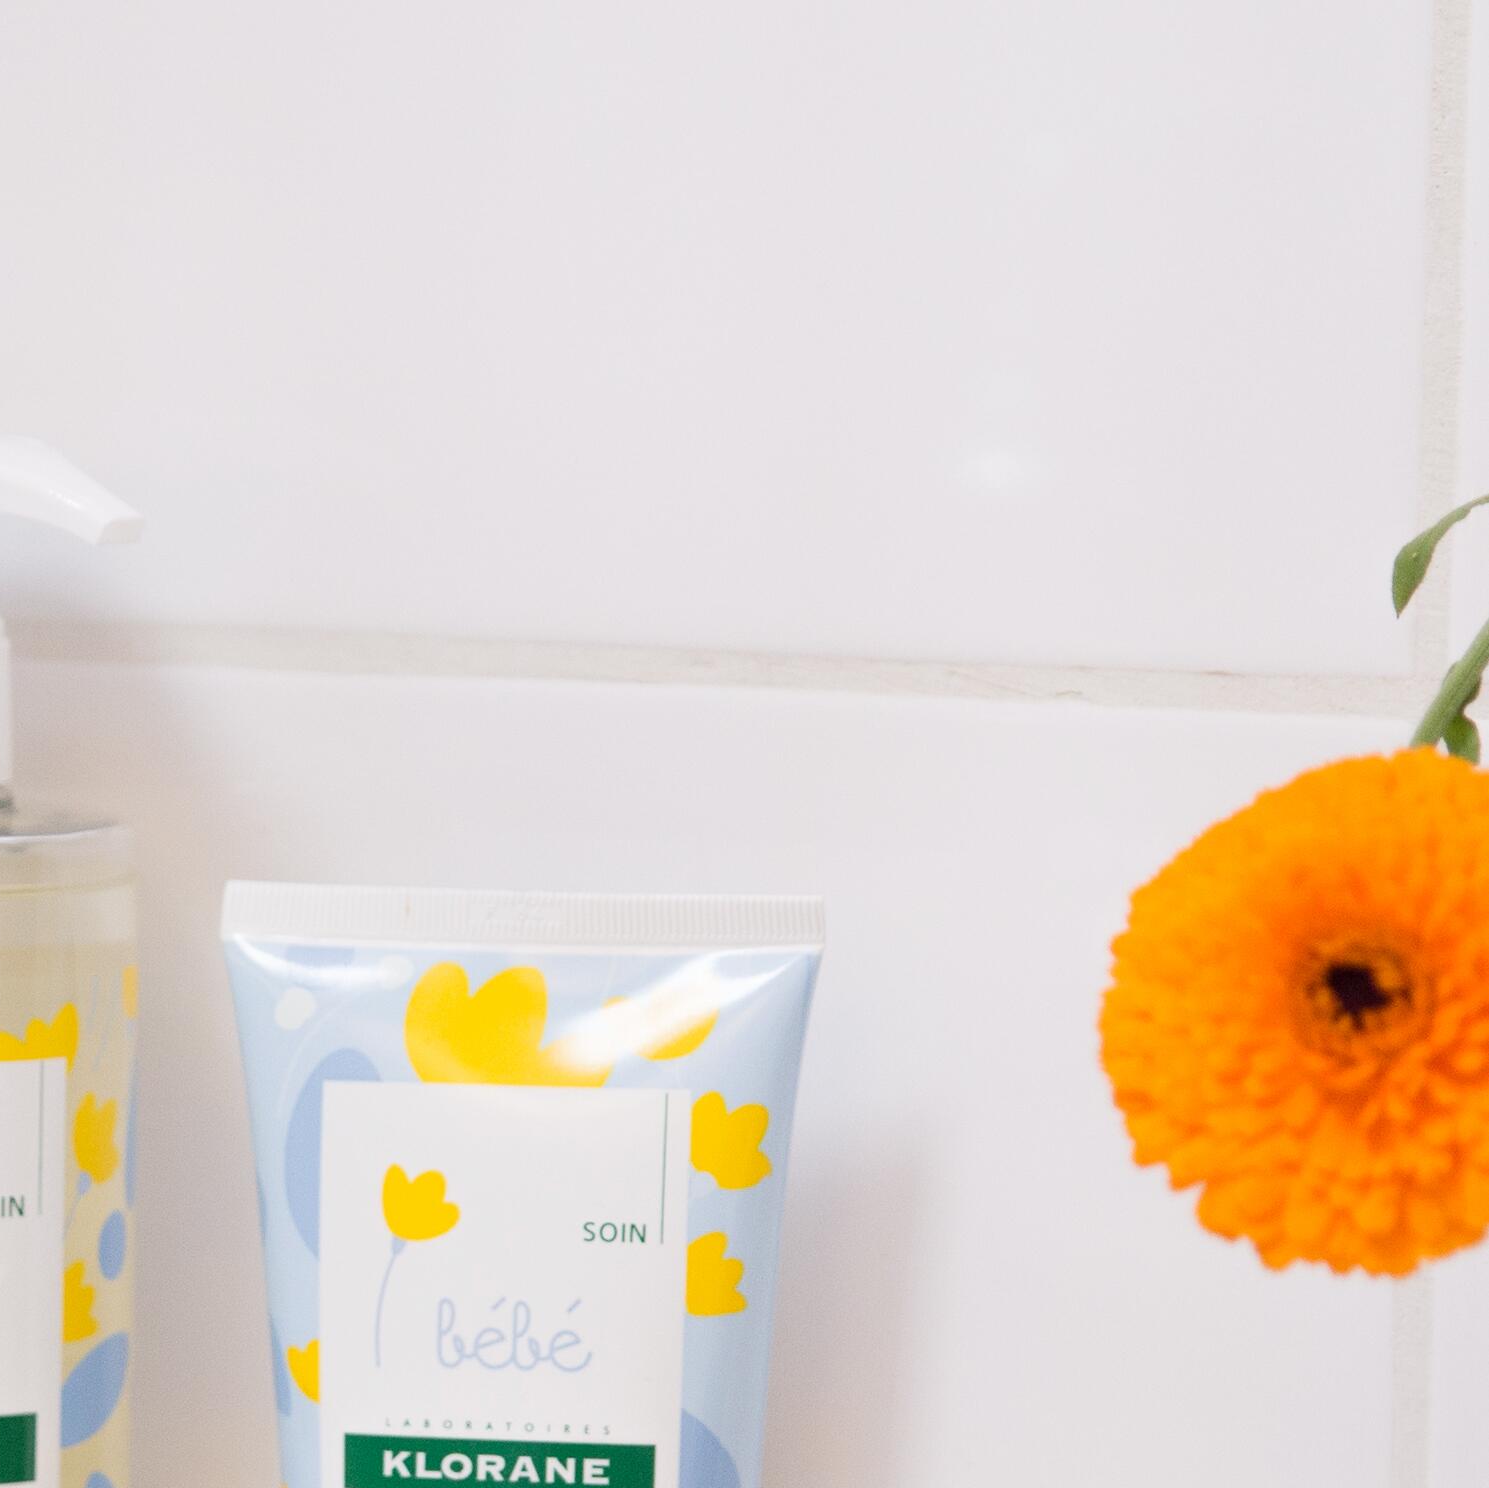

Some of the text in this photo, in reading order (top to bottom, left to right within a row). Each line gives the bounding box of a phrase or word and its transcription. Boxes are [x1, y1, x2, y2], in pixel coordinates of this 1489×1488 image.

[582, 1221, 647, 1244] SOIN
[436, 1296, 593, 1373] bébé
[385, 1418, 611, 1436] LABORATOIRES
[382, 1449, 610, 1486] KLORANE
